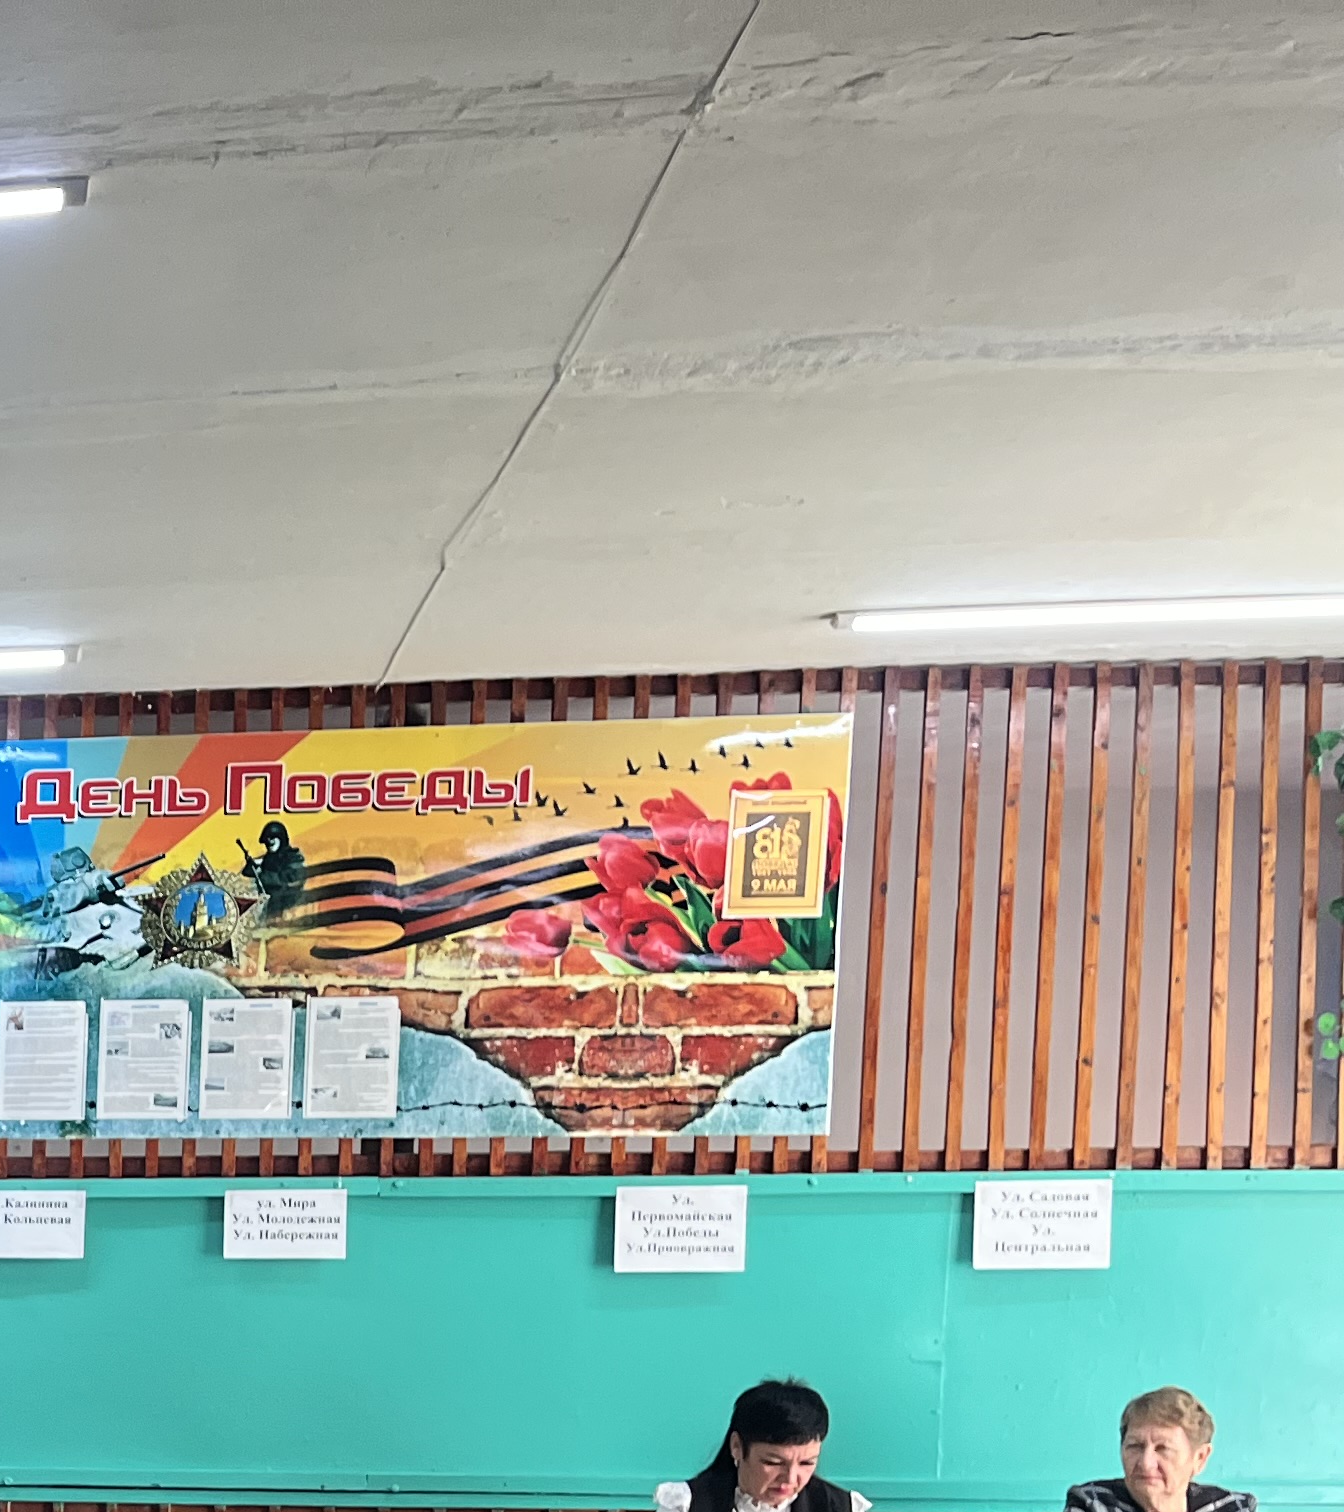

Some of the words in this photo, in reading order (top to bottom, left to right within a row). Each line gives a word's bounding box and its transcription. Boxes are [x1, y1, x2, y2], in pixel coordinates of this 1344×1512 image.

[751, 878, 761, 892] 9
[672, 1194, 694, 1205] Ул.
[1002, 1191, 1025, 1202] Ул.
[1029, 1190, 1090, 1202] Садовая
[256, 1200, 275, 1211] ул.
[280, 1197, 316, 1211] Мира
[4, 1213, 72, 1224] Кольцевая
[233, 1214, 253, 1224] Ул.
[258, 1213, 341, 1224] Молодежная
[632, 1210, 732, 1224] Первомайская
[992, 1207, 1015, 1219] Ул.
[1019, 1207, 1098, 1218] Солнечная
[233, 1230, 254, 1240] Ул.
[259, 1229, 339, 1243] Набережная
[1032, 1224, 1055, 1236] Ул.
[995, 1241, 1090, 1255] Центральная
